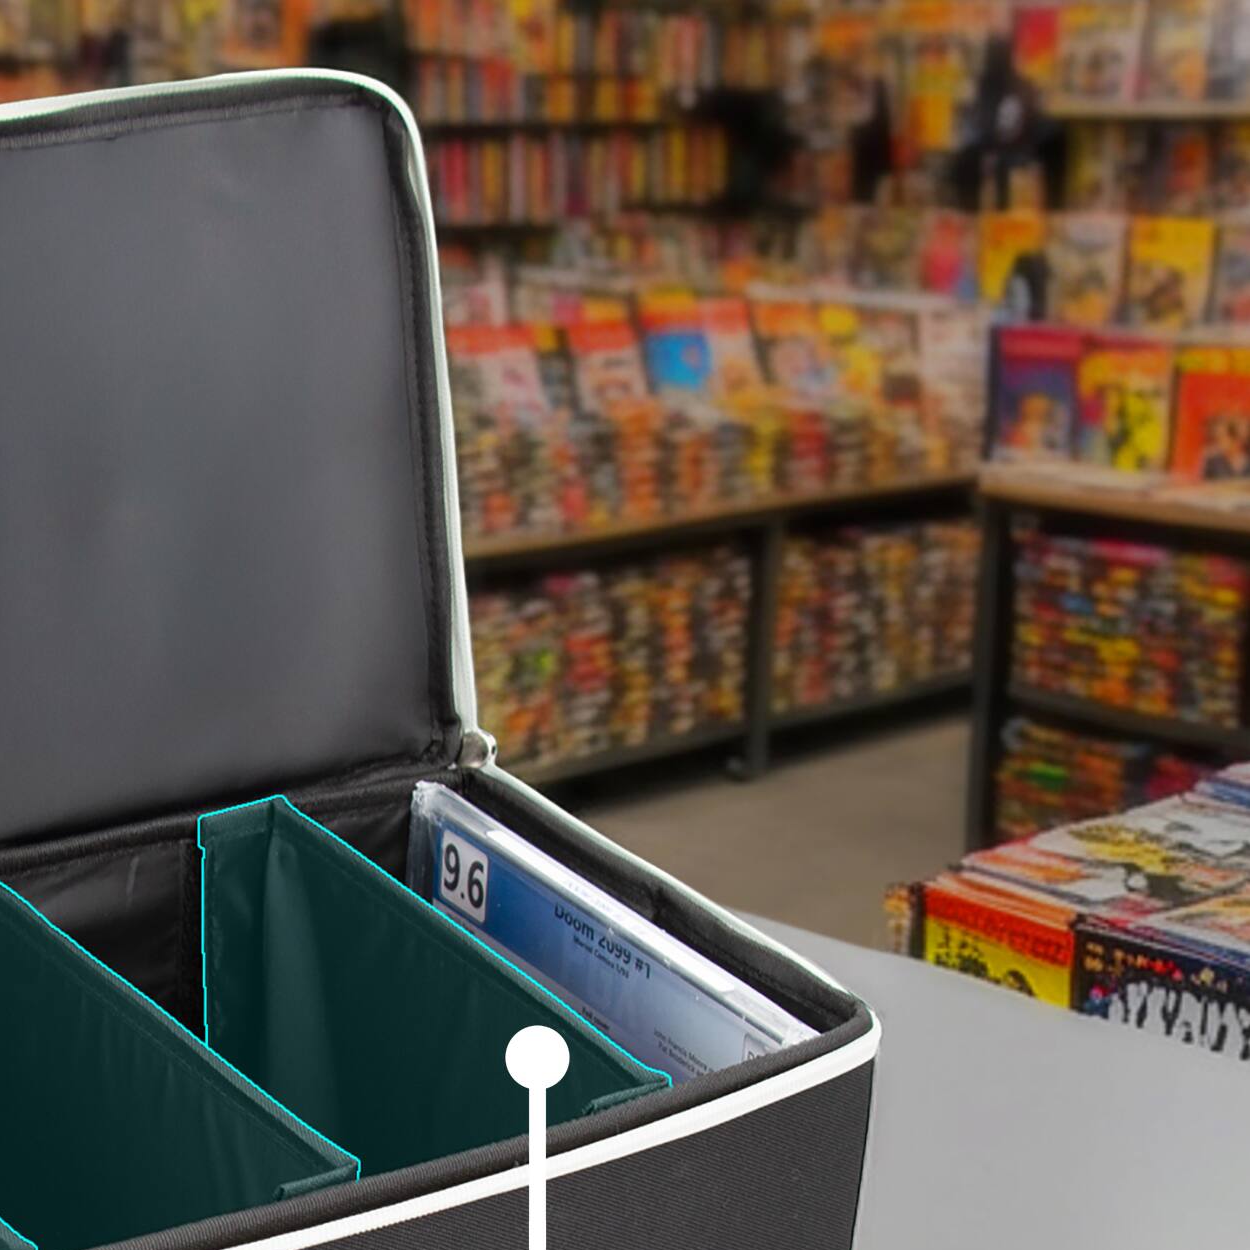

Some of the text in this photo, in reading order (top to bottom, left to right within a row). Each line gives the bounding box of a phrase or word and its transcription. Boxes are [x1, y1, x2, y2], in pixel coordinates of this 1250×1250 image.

[443, 843, 485, 909] 9.6
[554, 902, 595, 941] Doom
[634, 957, 651, 979] #1
